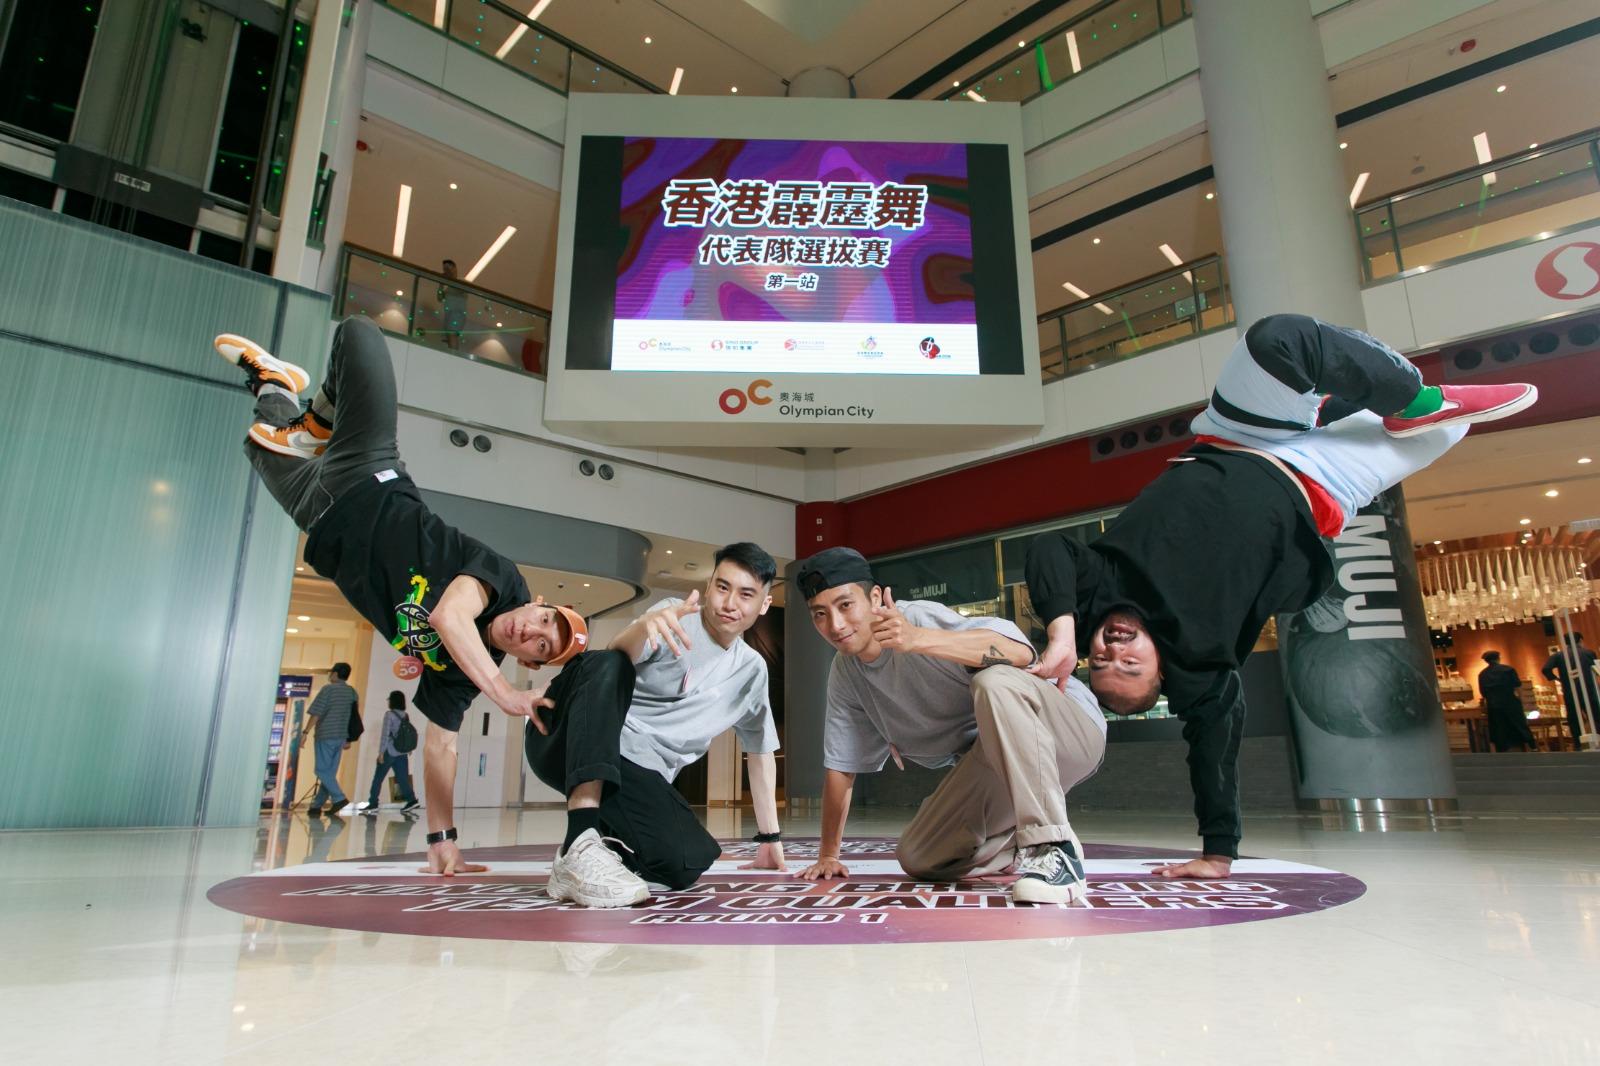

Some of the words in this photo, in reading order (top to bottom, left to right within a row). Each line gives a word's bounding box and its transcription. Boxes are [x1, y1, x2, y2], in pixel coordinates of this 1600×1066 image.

[662, 179, 927, 229] 香港霹靂舞
[699, 235, 890, 267] 代表隊選拔賽
[765, 274, 819, 291] 第一站
[779, 392, 815, 403] 奧海城
[779, 405, 845, 418] Olympian
[846, 405, 874, 418] City
[1332, 514, 1406, 641] MUJI
[923, 583, 947, 598] MUJI
[828, 882, 1279, 894] BREKING
[401, 896, 715, 911] TEM
[718, 895, 1289, 910] QUALIIERS
[629, 913, 844, 924] ROUND
[859, 913, 889, 924] 1
